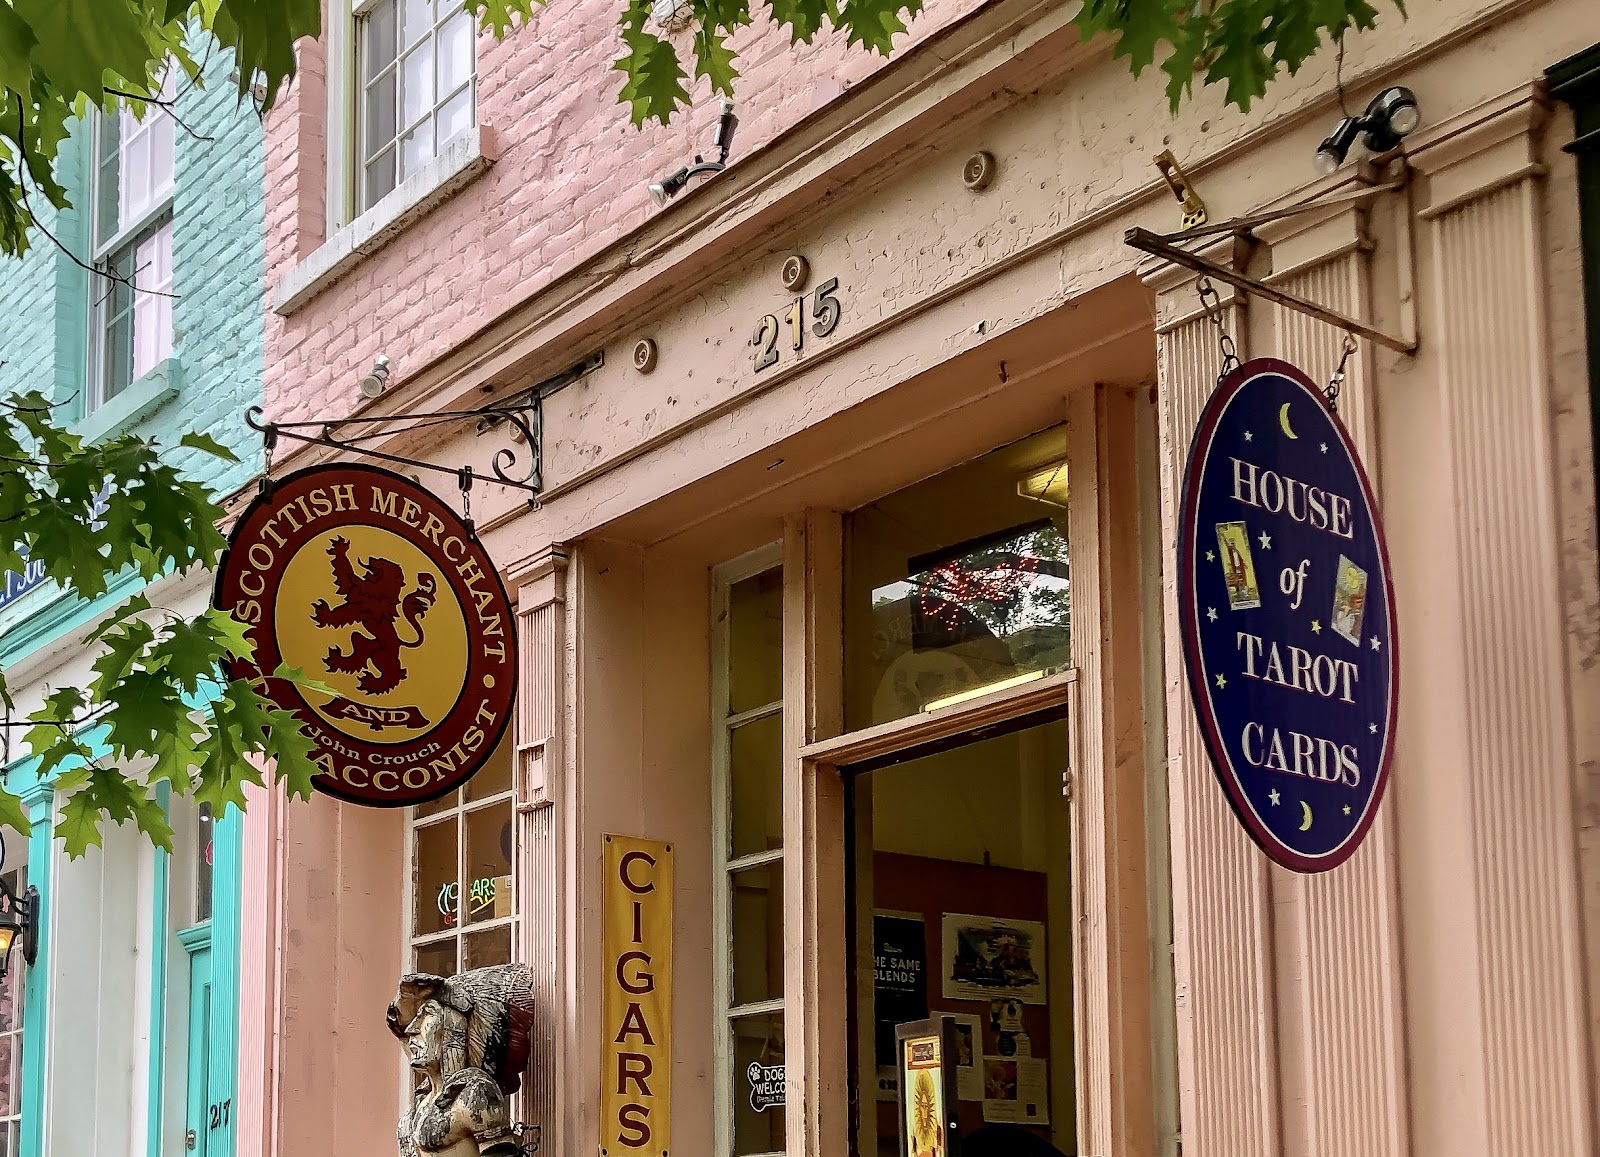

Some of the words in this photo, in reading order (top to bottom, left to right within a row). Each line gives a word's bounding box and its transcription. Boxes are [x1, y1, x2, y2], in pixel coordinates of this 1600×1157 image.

[752, 277, 841, 373] 215
[1228, 456, 1354, 539] HOUSE
[235, 483, 360, 624] SCOTTISH
[369, 485, 506, 664] MERCHANT
[1279, 558, 1311, 611] of
[1236, 632, 1359, 703] TAROT
[341, 704, 411, 722] AND
[297, 725, 361, 761] John
[367, 741, 442, 765] Crouch
[1241, 721, 1361, 787] CARDS
[449, 877, 496, 900] CARS
[873, 955, 887, 968] HE
[890, 957, 921, 971] SAME
[873, 969, 916, 983] BLENDS
[613, 850, 657, 1148] CIGARS
[755, 1081, 786, 1095] WELCO
[764, 1067, 786, 1082] DOG
[209, 1098, 231, 1131] 217
